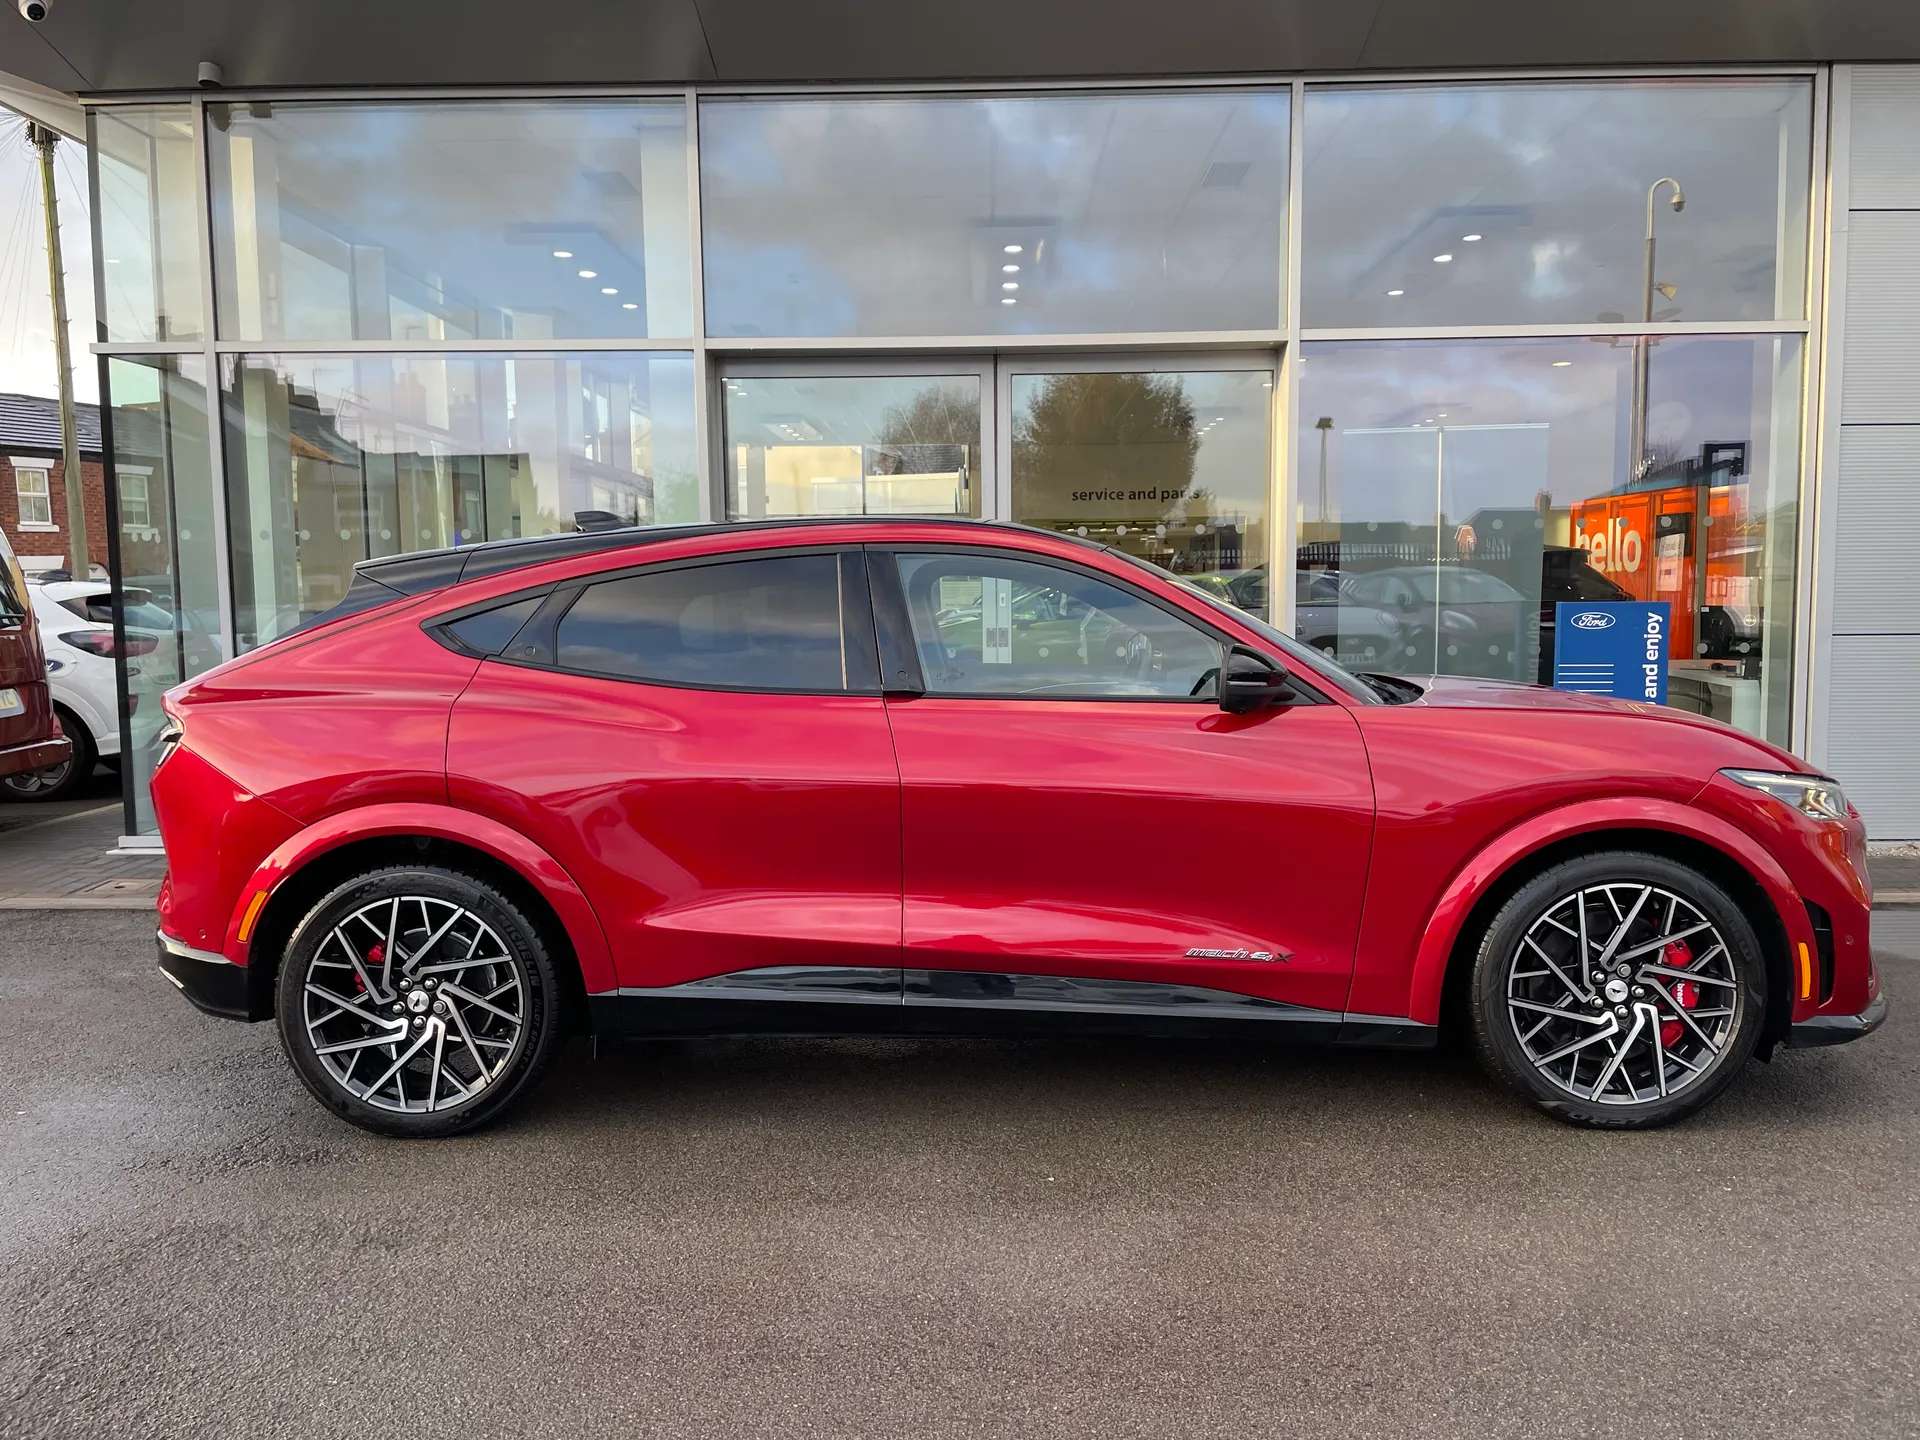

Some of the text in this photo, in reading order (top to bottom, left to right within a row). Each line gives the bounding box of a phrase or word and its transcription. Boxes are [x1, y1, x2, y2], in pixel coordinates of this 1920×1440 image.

[1072, 487, 1200, 503] service and pars
[1575, 518, 1642, 573] hello
[1578, 614, 1608, 627] Ford
[1644, 612, 1664, 661] enjoy
[1642, 664, 1659, 698] and
